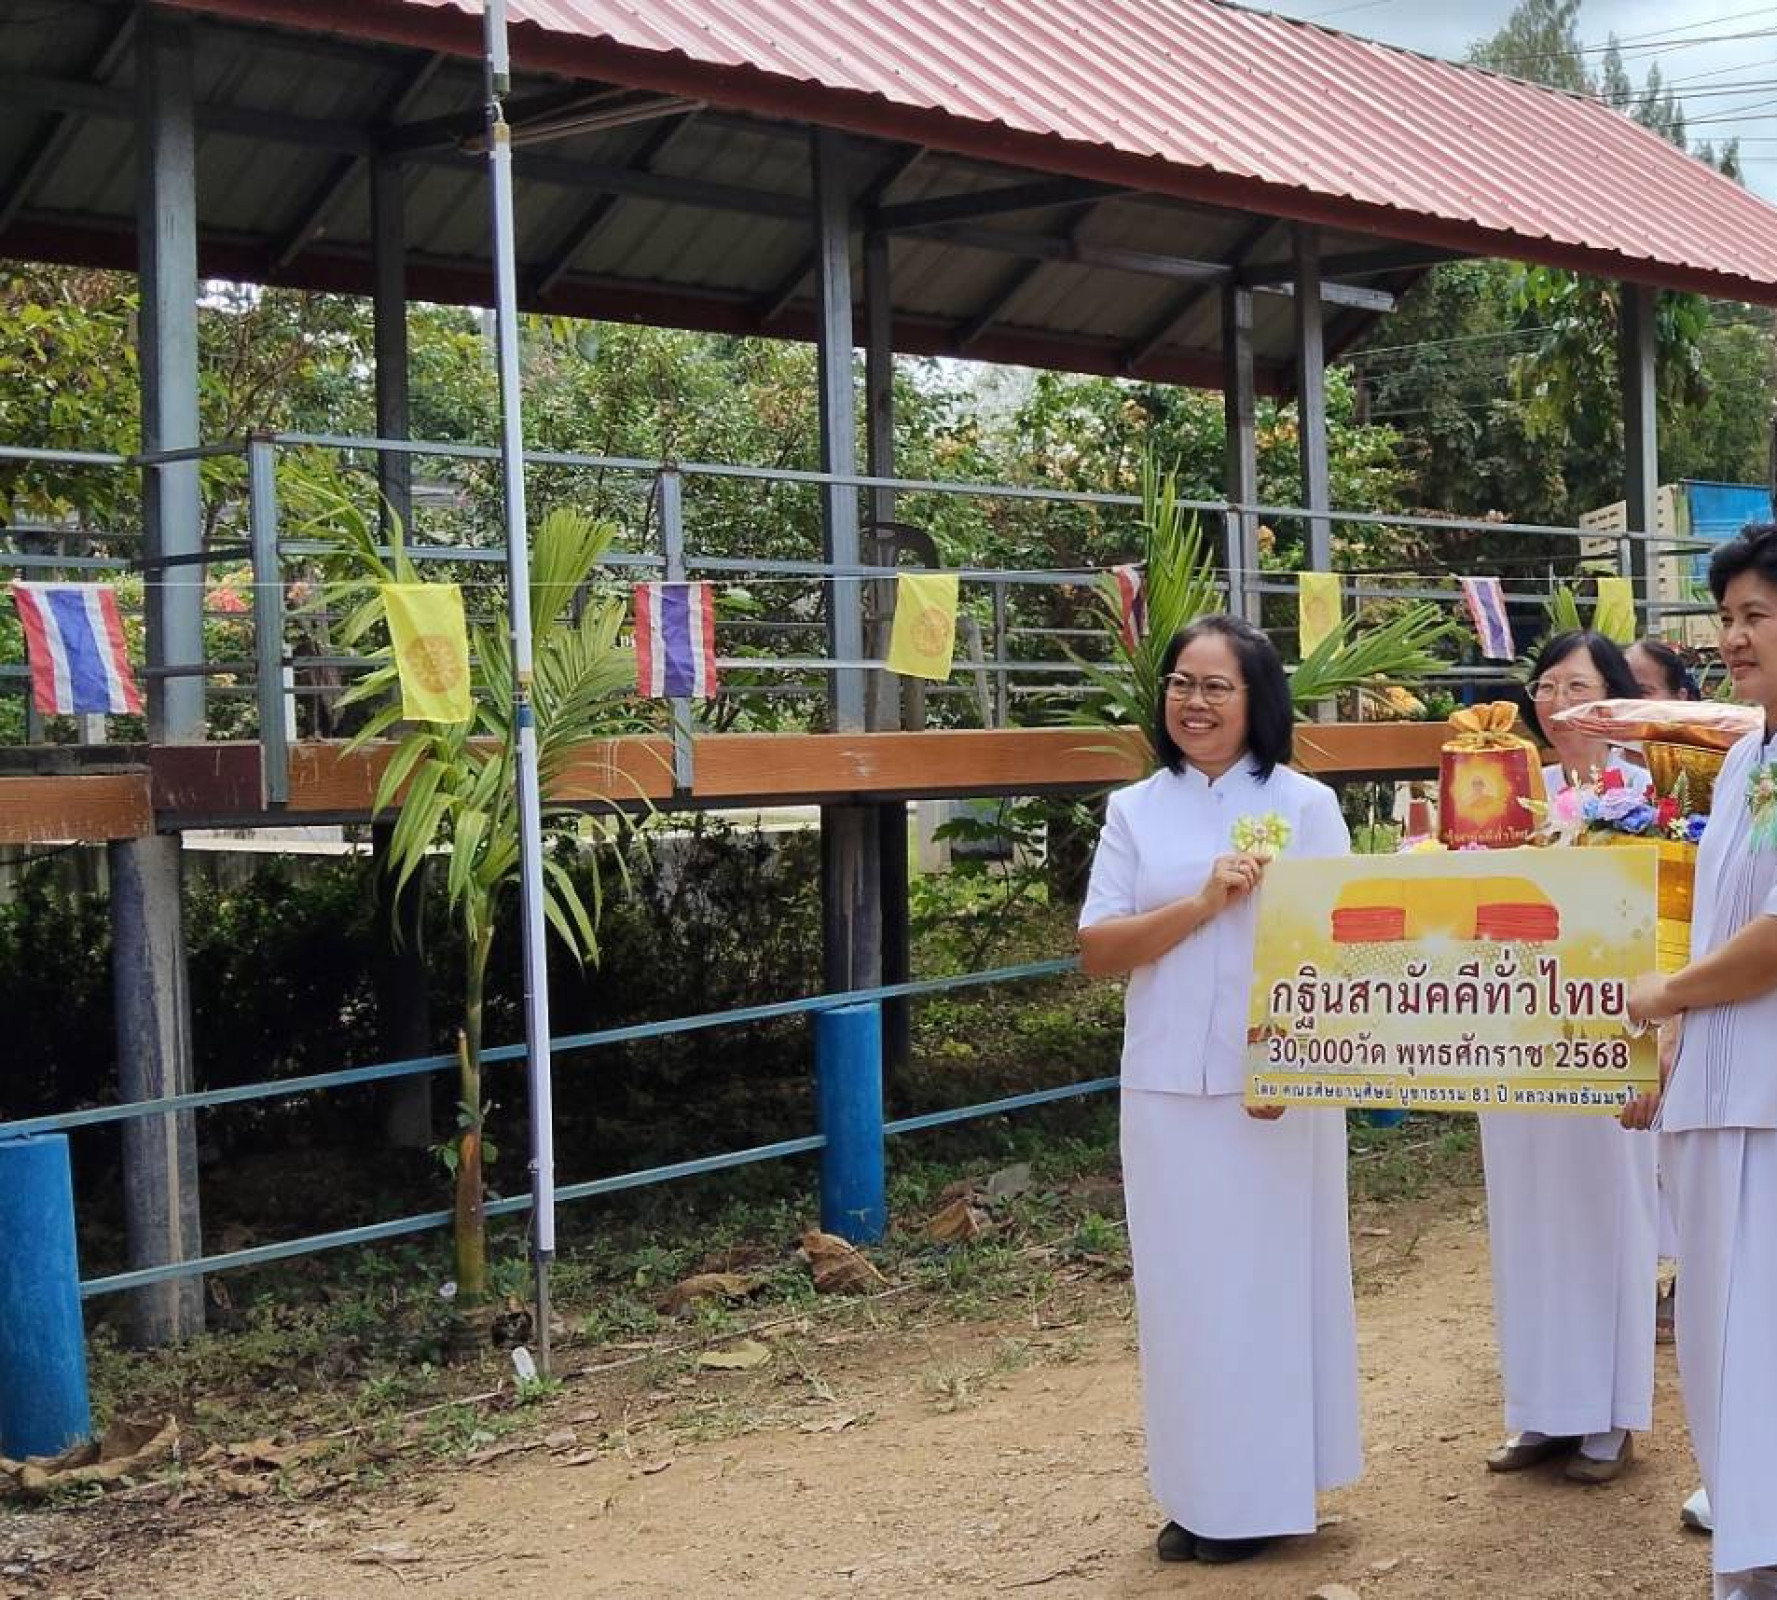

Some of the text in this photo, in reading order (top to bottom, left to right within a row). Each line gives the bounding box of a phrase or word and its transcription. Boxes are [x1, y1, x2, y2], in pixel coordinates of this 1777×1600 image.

[1272, 948, 1626, 1030] กฐินสามัคคีทั่วไทย
[1396, 1033, 1545, 1077] พุทธศักราช
[1555, 1040, 1630, 1070] 2568
[1472, 1087, 1489, 1102] 81
[1497, 1084, 1508, 1103] ปี
